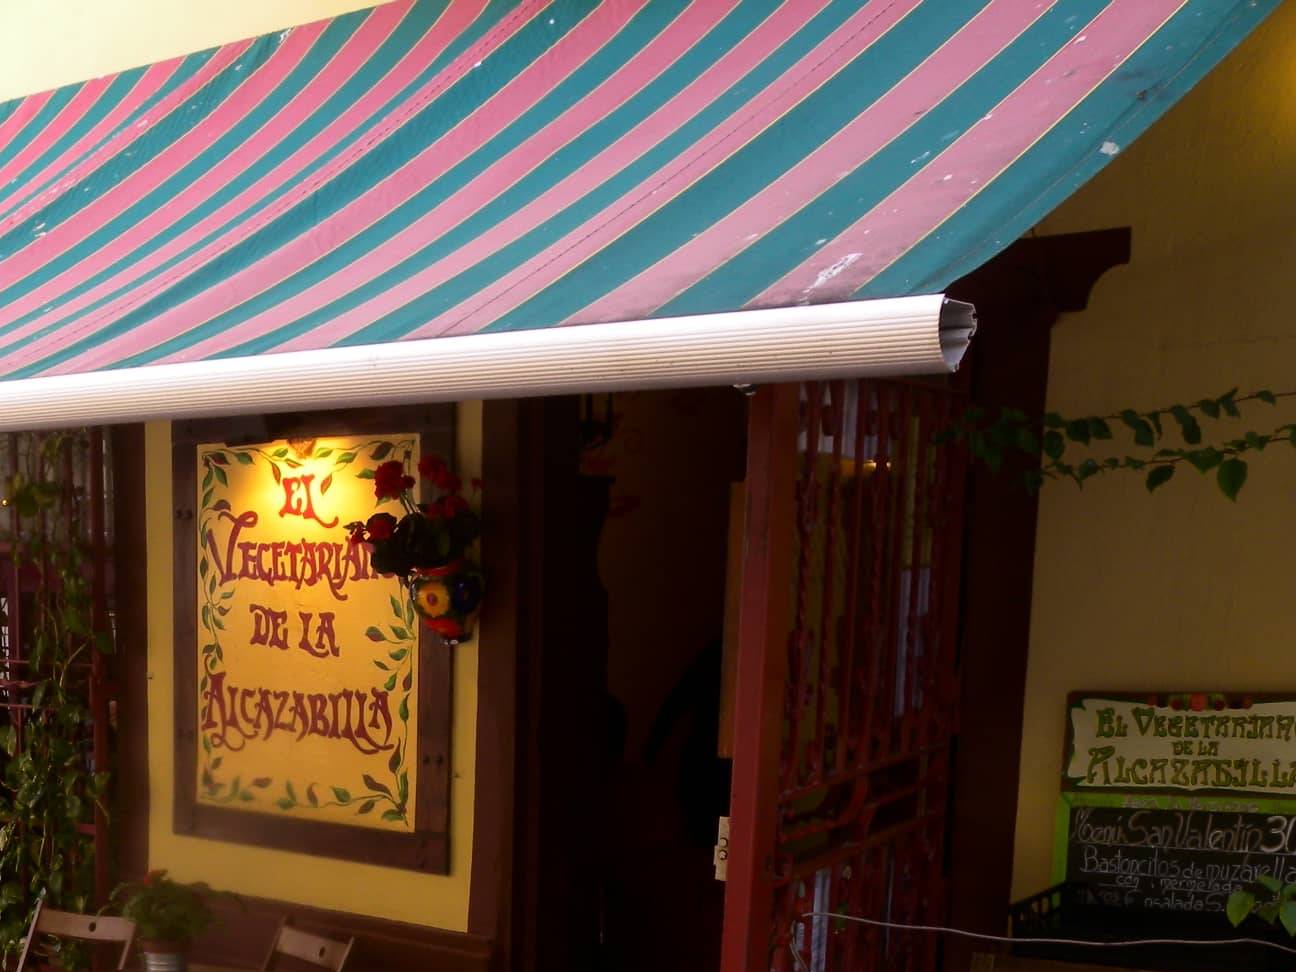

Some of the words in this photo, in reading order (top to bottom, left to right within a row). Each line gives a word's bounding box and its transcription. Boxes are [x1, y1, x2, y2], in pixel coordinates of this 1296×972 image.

[279, 473, 340, 529] EL
[206, 511, 396, 600] VEGETARIAN
[249, 604, 289, 649] DE
[298, 608, 340, 657] LA
[201, 653, 401, 755] ALCAZABILLA
[1095, 707, 1128, 738] EL
[1131, 707, 1296, 742] VEGETARIAN
[1172, 740, 1193, 756] DE
[1197, 740, 1220, 756] LA
